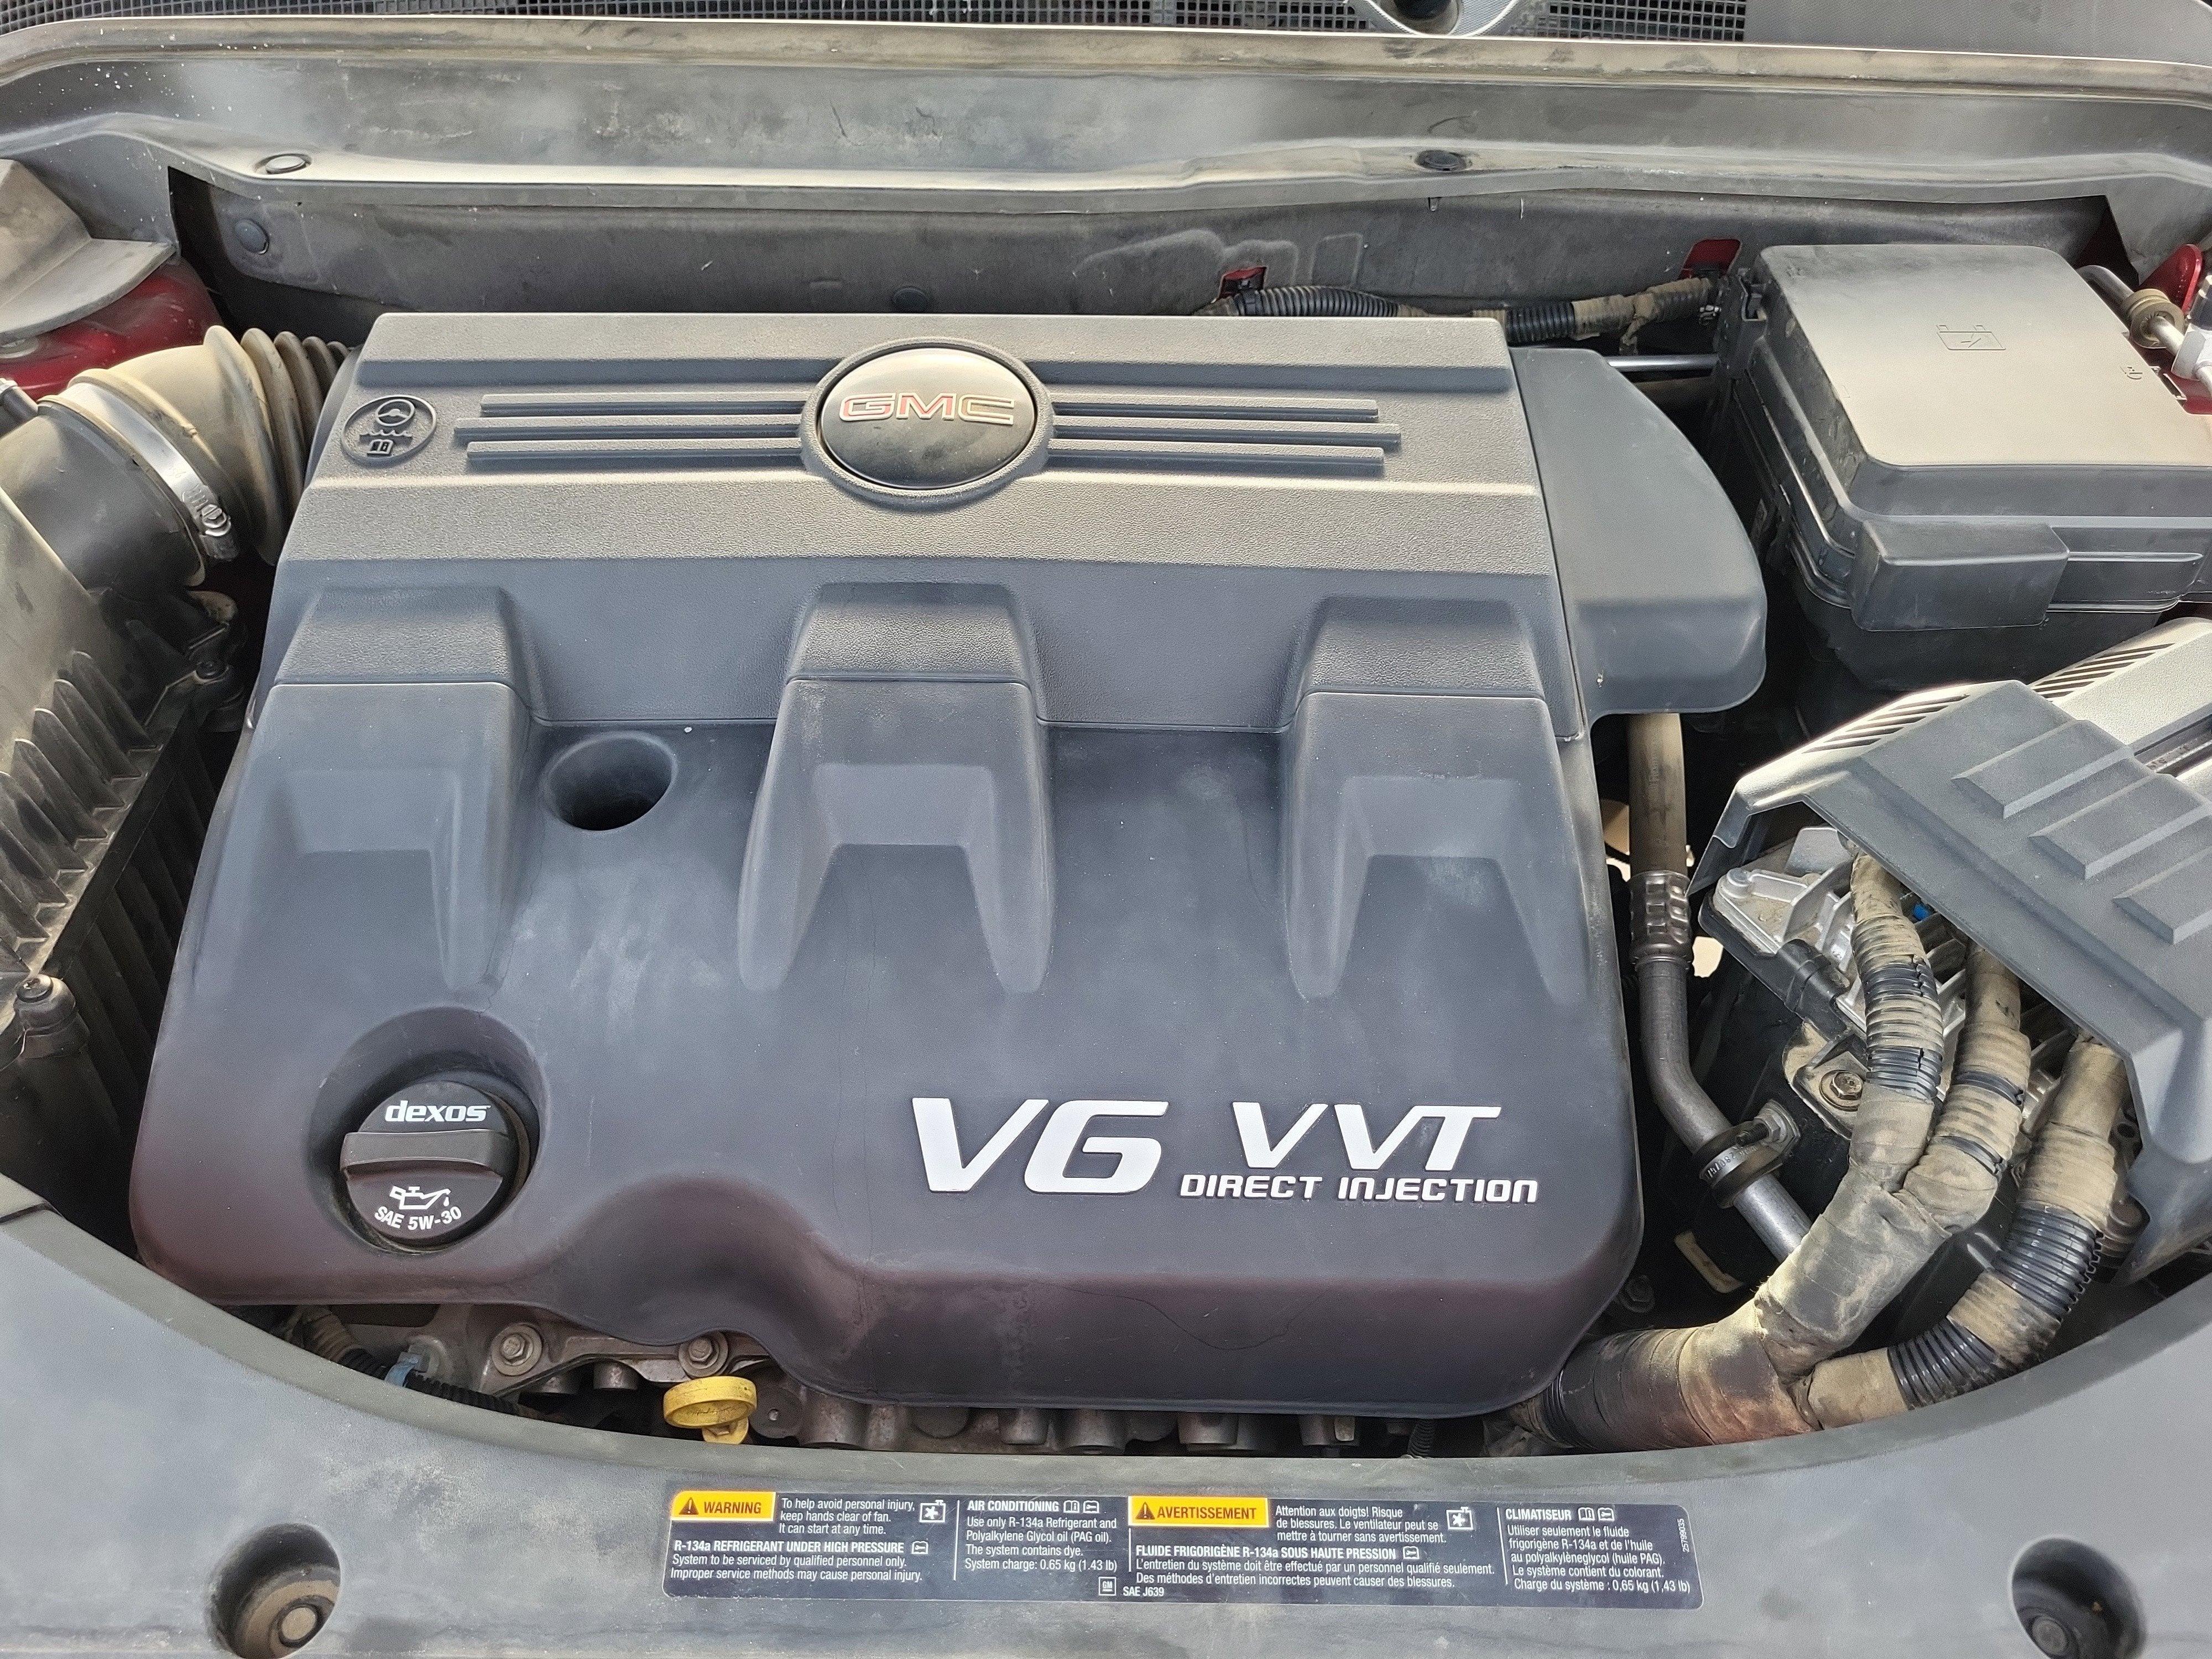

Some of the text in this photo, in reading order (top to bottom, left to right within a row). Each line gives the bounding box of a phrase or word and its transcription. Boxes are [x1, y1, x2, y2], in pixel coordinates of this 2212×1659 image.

[839, 392, 1015, 426] GMC
[385, 1100, 491, 1123] dexos
[911, 1097, 1502, 1194] V6 VVT
[1181, 1175, 1538, 1204] DIRECT INJECTION
[374, 1206, 462, 1231] SAE 5W-30
[703, 1501, 761, 1515] WARNING
[781, 1497, 915, 1513] To help avoid personal injury,
[967, 1500, 1059, 1512] AIR CONDITIONING
[1275, 1505, 1403, 1520] Attention aux doigts! Risque
[780, 1510, 891, 1523] keep hands clear of fan.
[1157, 1506, 1257, 1520] AVERTISSEMENT
[1505, 1508, 1572, 1521] CLIMATISEUR
[779, 1522, 886, 1536] It can start at any time.
[967, 1516, 1117, 1530] Use only R-134a Refrigerant and
[1276, 1517, 1438, 1532] de blessures. Le ventilateur peut se
[1507, 1524, 1629, 1537] Utiliser seulement le fluide
[966, 1529, 1112, 1545] Polyalkylene Glycol oil (PAG oil).
[1276, 1529, 1447, 1543] mettre à tourner sans avertissement.
[1677, 1518, 1689, 1552] 25799035
[674, 1540, 904, 1553] R-134a REFRIGERANT UNDER HIGH PRESSURE
[965, 1543, 1083, 1558] The system contains dye.
[1135, 1543, 1396, 1560] FLUIDE FRIGORIGÈNE R-134a SOUS HAUTE PRESSION
[1509, 1537, 1559, 1552] frigorigène
[1561, 1538, 1597, 1550] R-134a
[1598, 1538, 1609, 1550] et
[1610, 1538, 1623, 1551] de
[672, 1553, 907, 1569] System to be serviced by qualified personnel only.
[964, 1557, 1117, 1572] System charge: 0.65 kg (1.43 lb)
[1187, 1558, 1199, 1570] du
[1202, 1558, 1241, 1573] système
[1243, 1559, 1262, 1571] doit
[1264, 1559, 1282, 1571] être
[1285, 1560, 1323, 1572] effectué
[1325, 1563, 1341, 1574] par
[1343, 1563, 1355, 1572] un
[1358, 1561, 1404, 1575] personnel
[1406, 1561, 1441, 1575] qualifié
[1442, 1562, 1495, 1574] seulement.
[1510, 1551, 1665, 1567] au polyalkylèneglycol (huile PAG).
[670, 1567, 922, 1583] Improper service methods may cause personal injury.
[1512, 1564, 1664, 1579] Le système contient du colorant.
[1136, 1572, 1155, 1583] Des
[1156, 1572, 1203, 1584] méthodes
[1258, 1573, 1311, 1585] incorrectes
[1313, 1574, 1352, 1588] peuvent
[1353, 1577, 1385, 1587] causer
[1387, 1575, 1405, 1587] des
[1406, 1575, 1455, 1588] blessures.
[1514, 1577, 1548, 1592] Charge
[1550, 1578, 1563, 1590] du
[1564, 1578, 1604, 1593] système
[1611, 1579, 1634, 1592] 0,65
[1636, 1579, 1649, 1593] kg
[1651, 1579, 1676, 1593] (1,43
[1677, 1579, 1691, 1594] lb)
[1123, 1585, 1165, 1597] SAE J639
